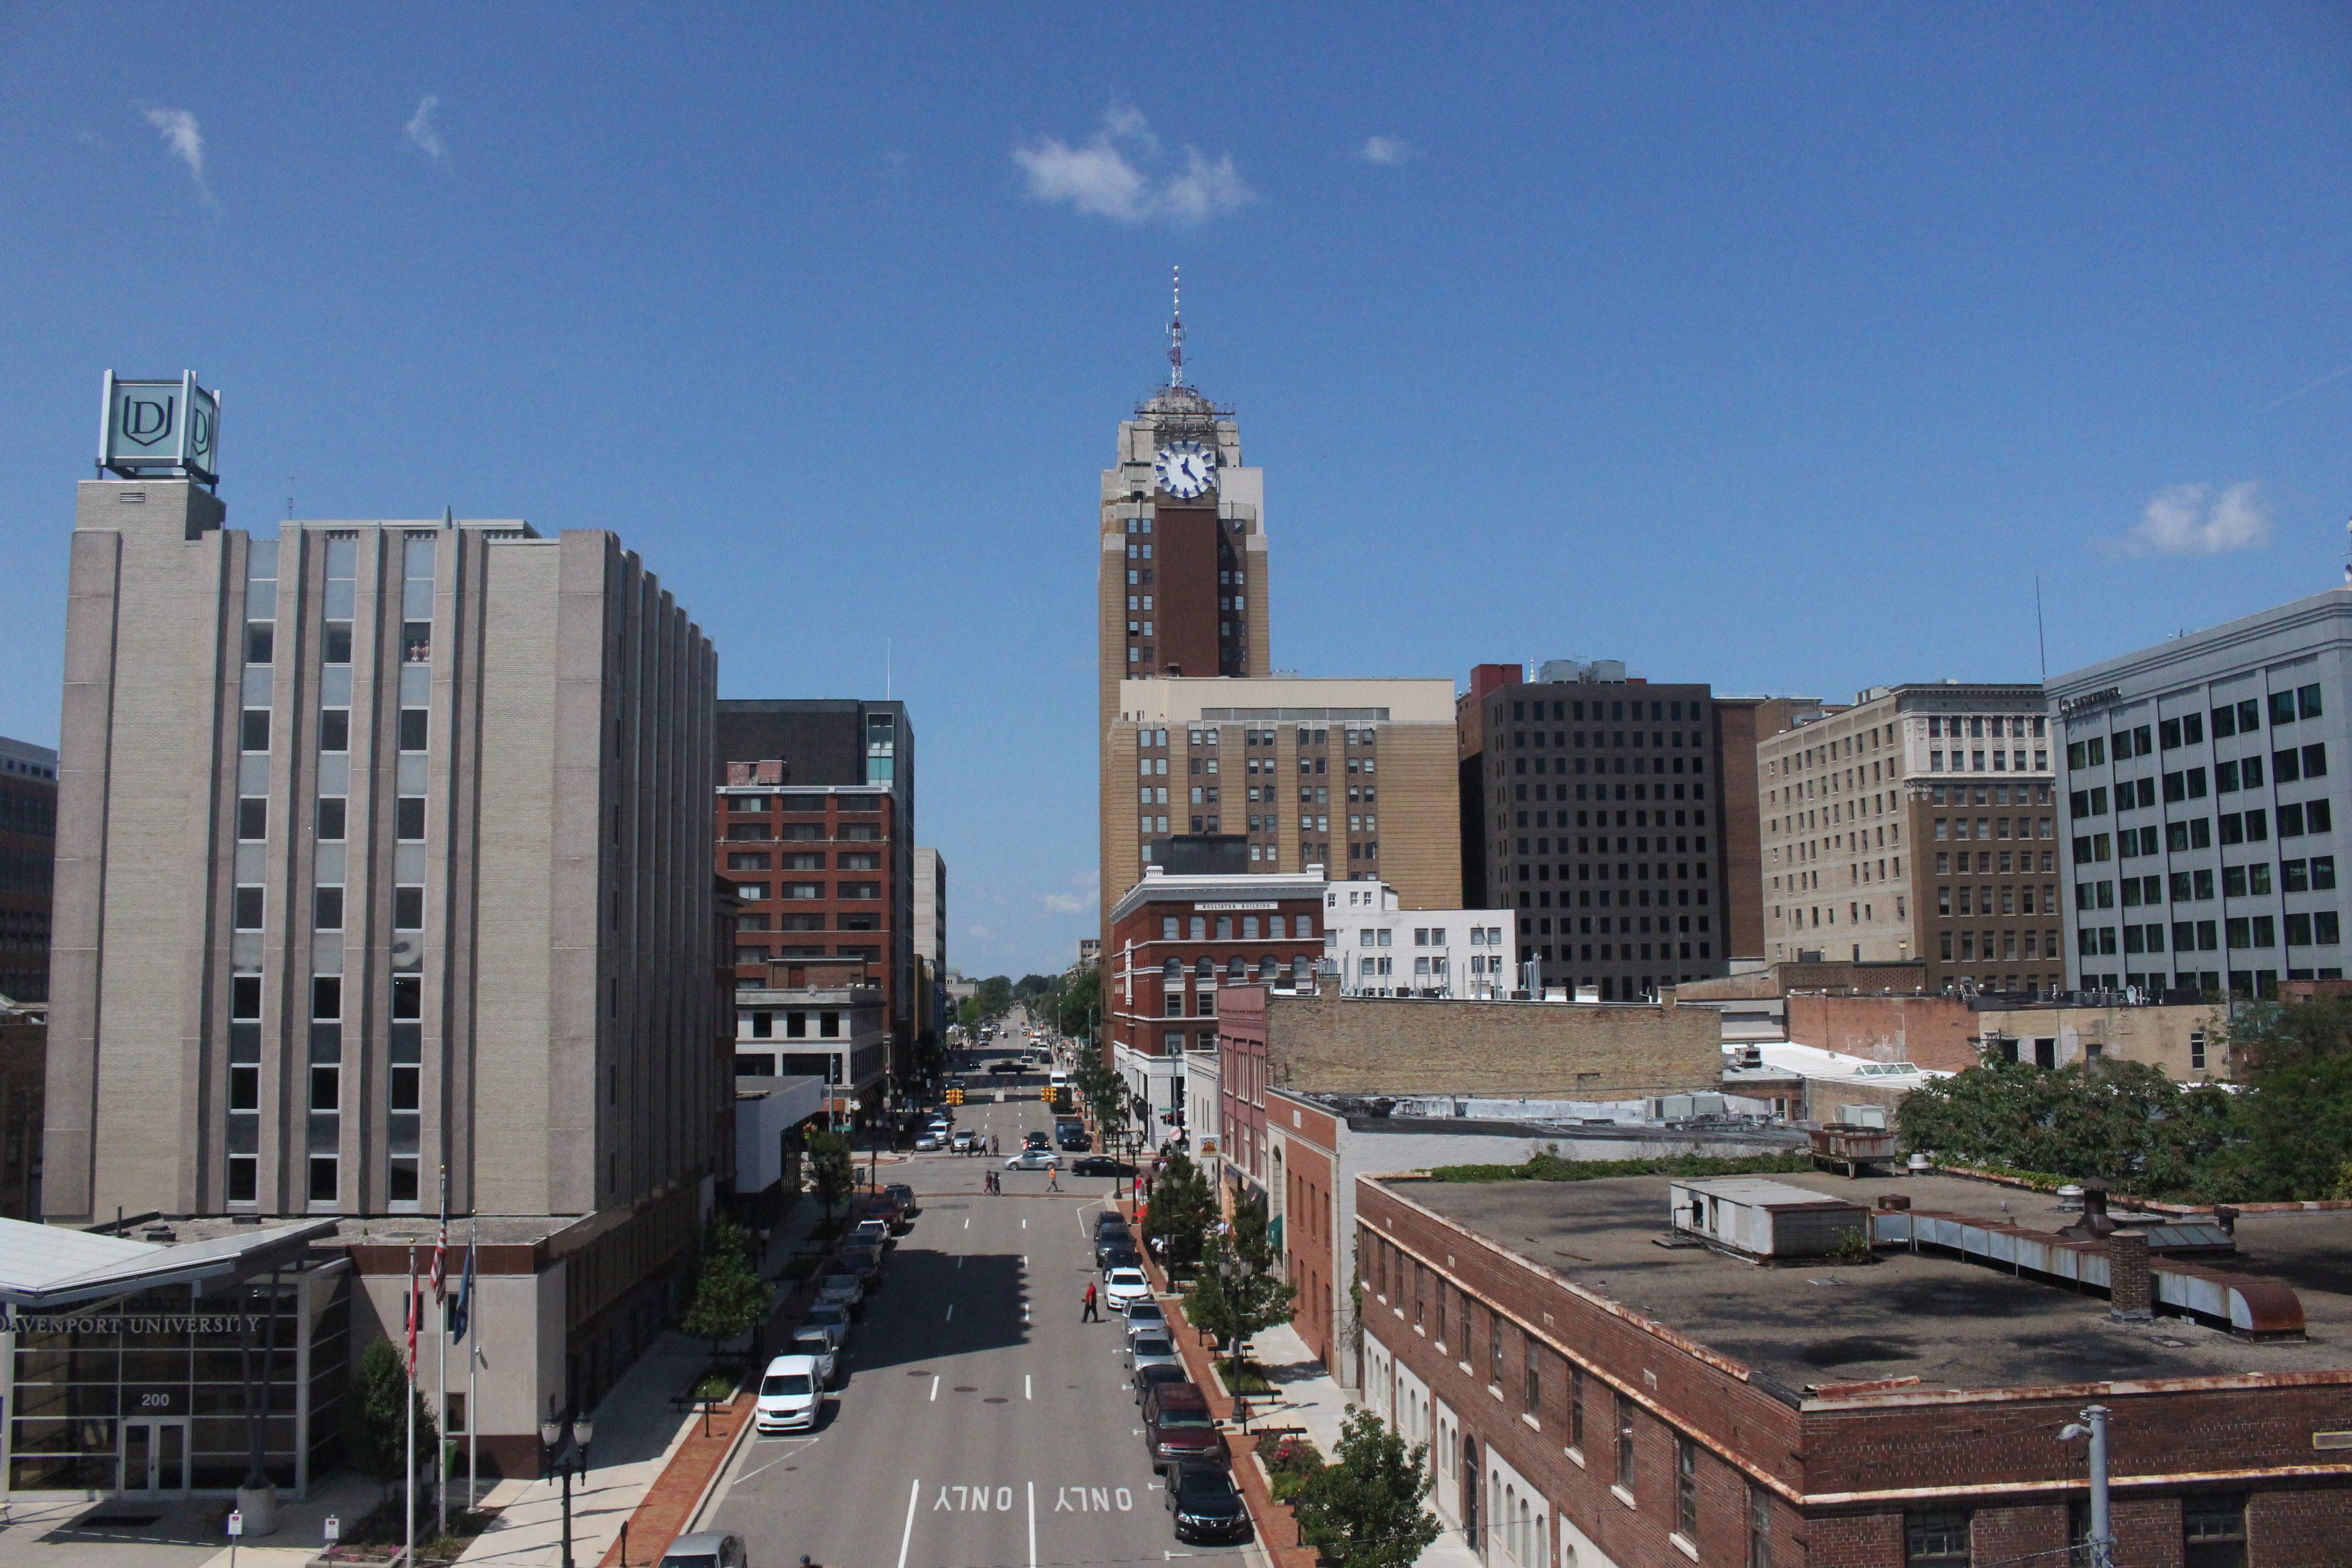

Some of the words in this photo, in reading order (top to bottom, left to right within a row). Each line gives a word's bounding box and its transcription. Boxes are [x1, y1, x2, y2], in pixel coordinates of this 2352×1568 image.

[130, 1317, 260, 1333] UNIVERSITY
[142, 1394, 170, 1406] 200
[933, 1486, 1012, 1511] ONLY
[1055, 1487, 1132, 1512] ONLY
